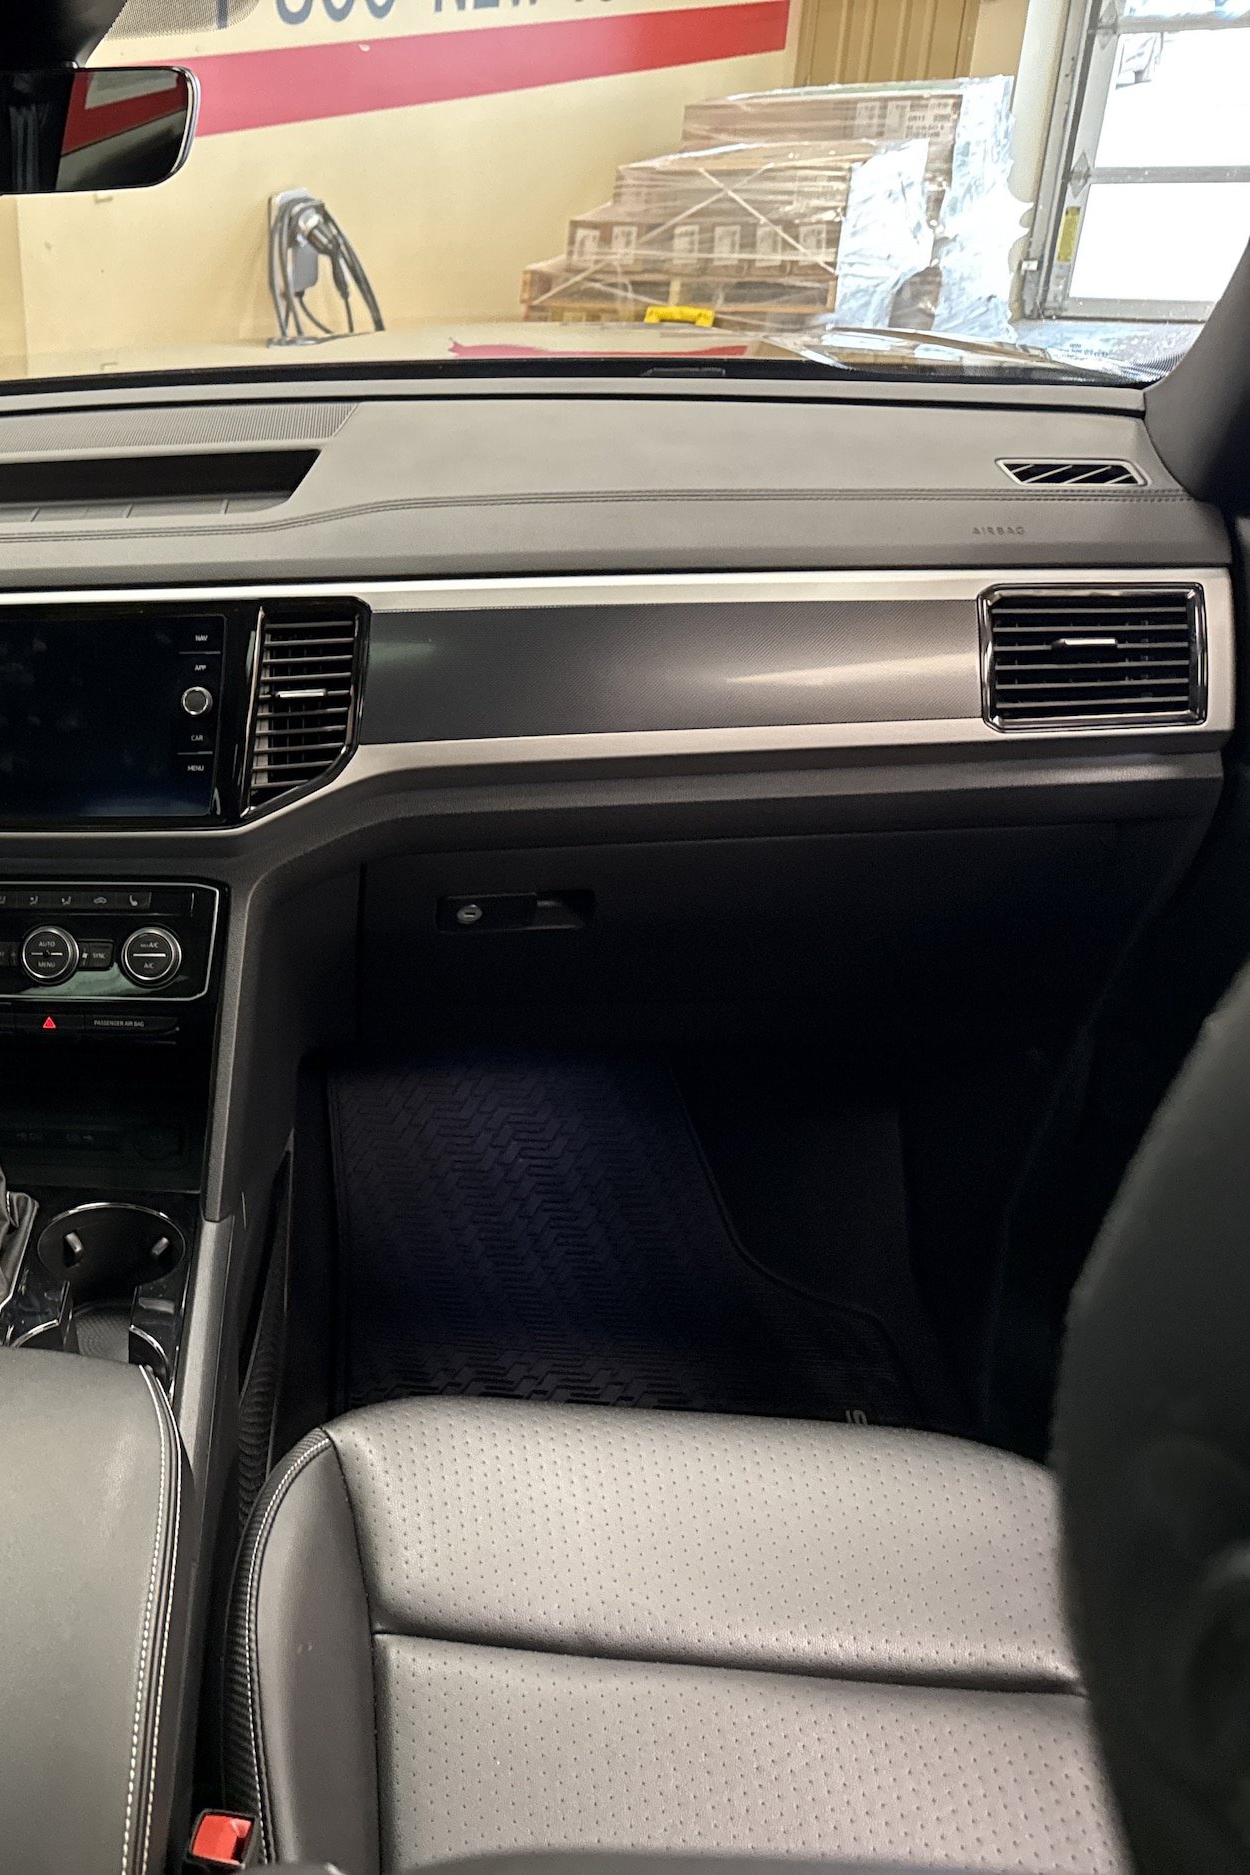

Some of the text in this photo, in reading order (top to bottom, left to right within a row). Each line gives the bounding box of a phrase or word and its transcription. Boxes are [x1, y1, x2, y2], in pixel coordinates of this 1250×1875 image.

[972, 526, 1026, 536] AIRBAG
[195, 634, 209, 642] NAV
[194, 664, 207, 672] APP
[38, 940, 56, 948] AUTO
[143, 961, 155, 969] A/C
[93, 1019, 124, 1027] PASSENGER
